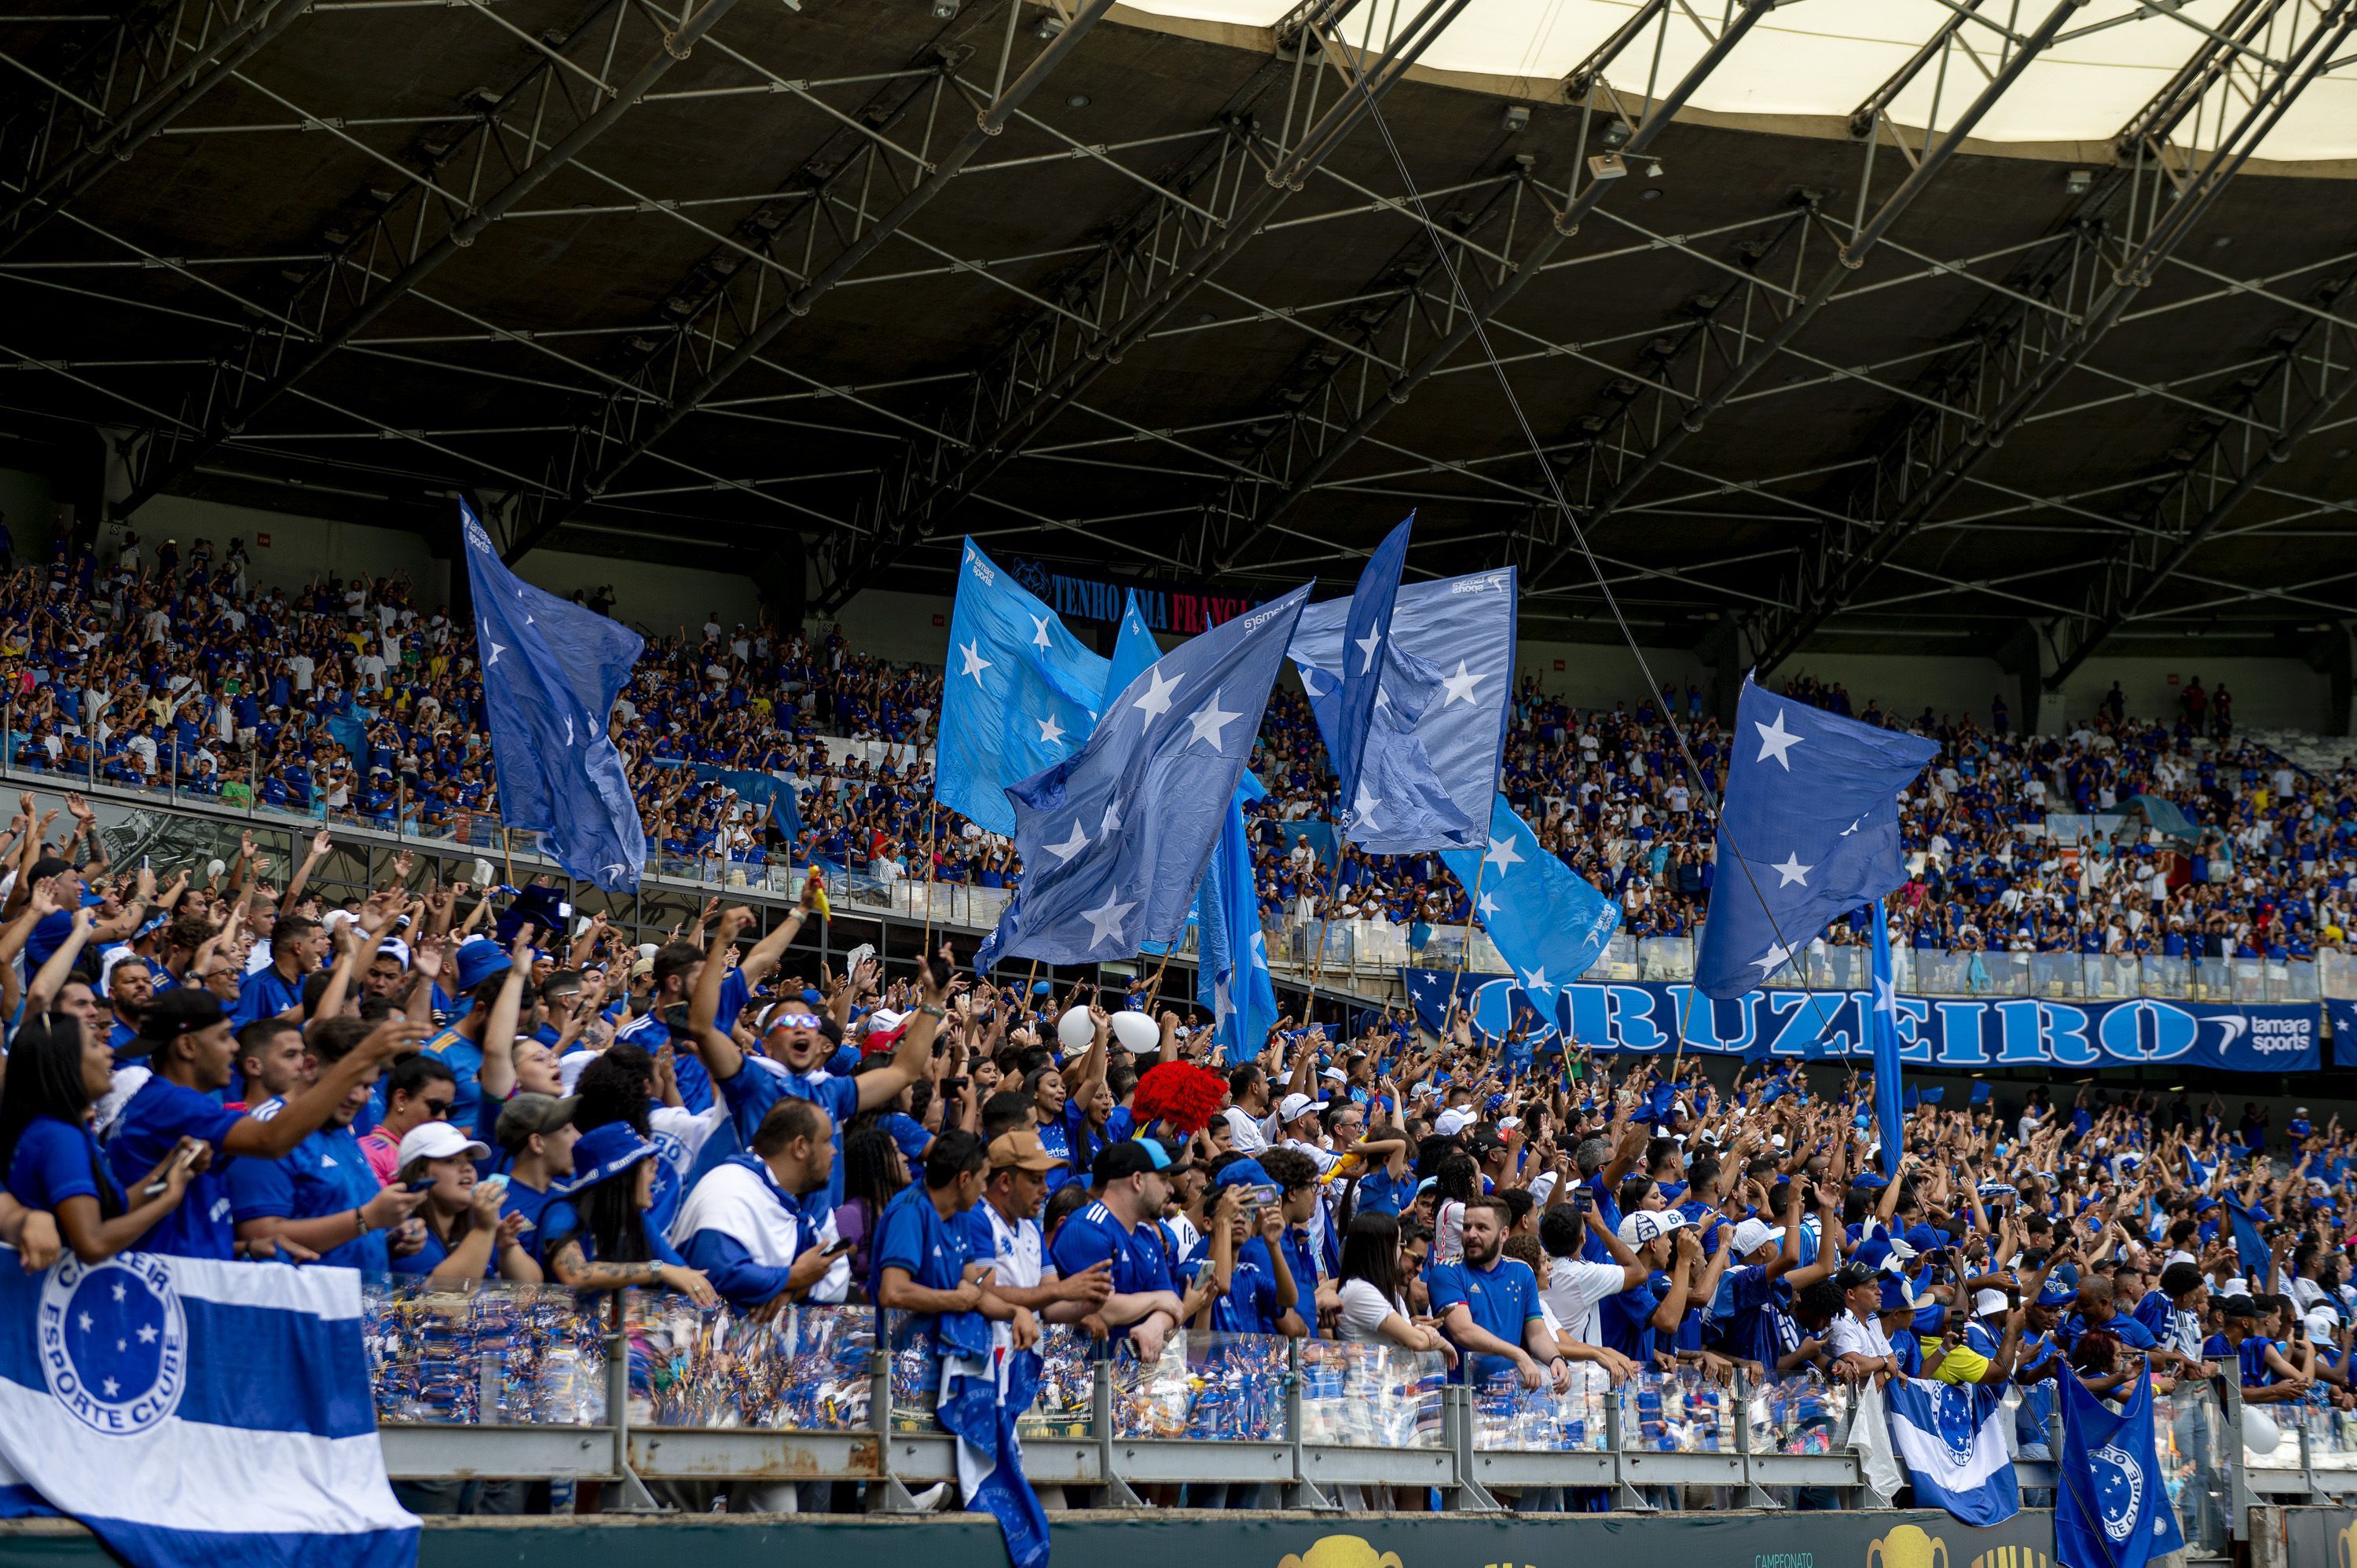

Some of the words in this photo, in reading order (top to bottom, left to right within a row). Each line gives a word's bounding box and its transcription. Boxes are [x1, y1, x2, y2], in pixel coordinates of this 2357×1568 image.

[468, 531, 490, 554] sports
[973, 565, 992, 587] sports
[975, 556, 995, 579] tamara
[1051, 574, 1120, 622] TENHO
[1594, 903, 1611, 930] tamara
[1601, 907, 1617, 932] sports
[1469, 978, 2199, 1064] CRUZEIRO
[2251, 1016, 2311, 1034] tamara
[2252, 1033, 2311, 1055] sports
[1047, 1146, 1069, 1158] etfair
[44, 1304, 124, 1429] ESPORTE
[131, 1335, 179, 1423] CLUBE
[1755, 1552, 1813, 1568] CAMPEONATO
